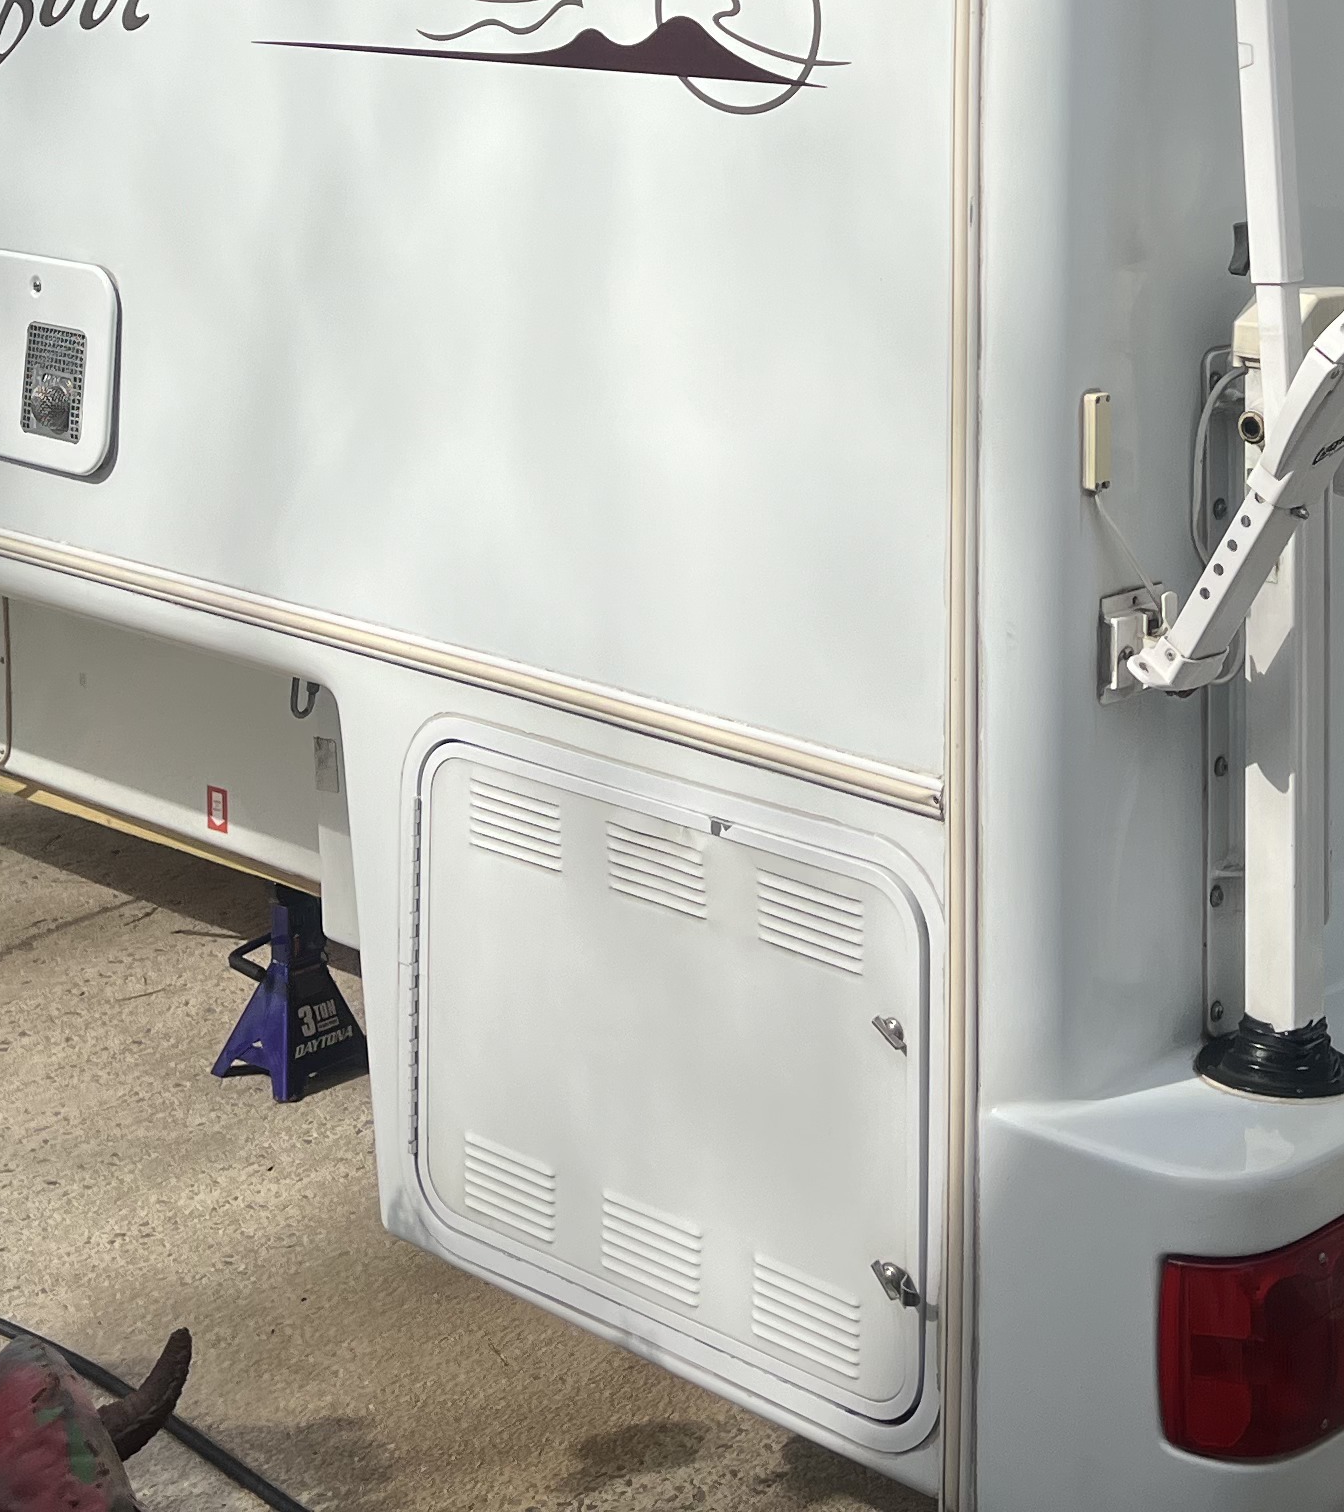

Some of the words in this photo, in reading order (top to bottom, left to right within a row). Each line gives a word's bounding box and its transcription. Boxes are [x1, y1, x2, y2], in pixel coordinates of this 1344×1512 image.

[297, 1004, 316, 1037] 3
[313, 998, 337, 1021] TON
[294, 1024, 353, 1059] DAYTONA
